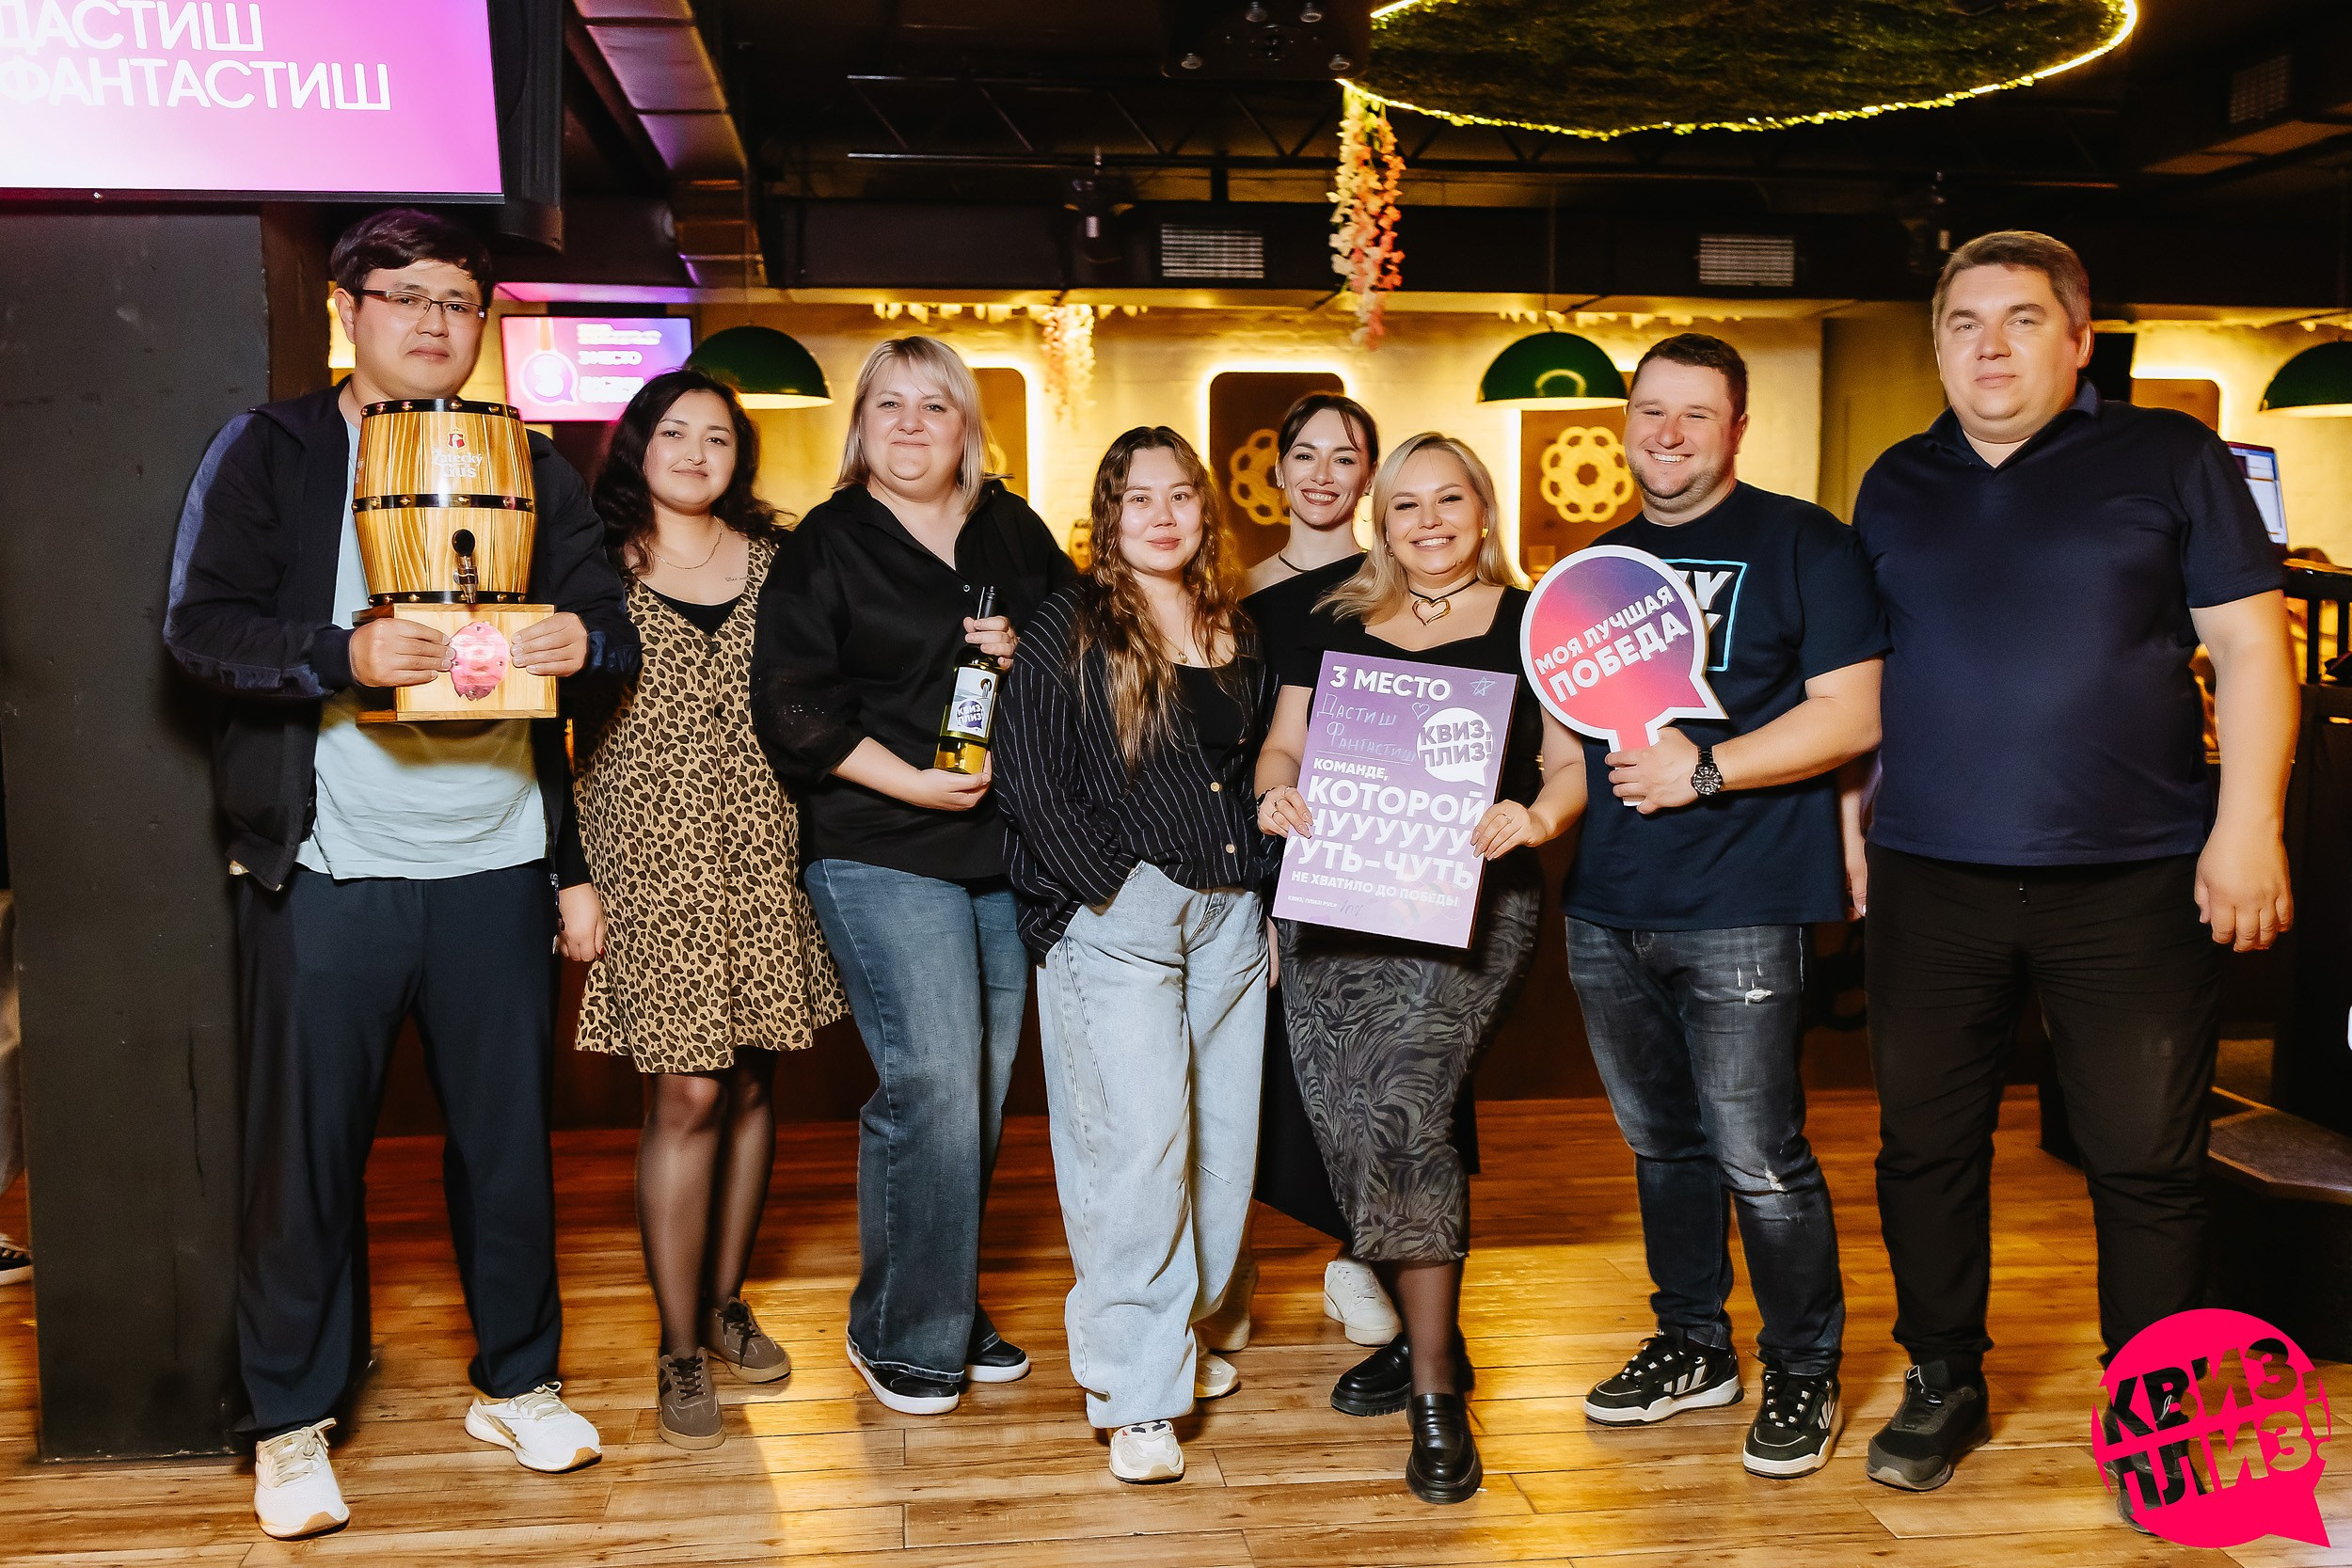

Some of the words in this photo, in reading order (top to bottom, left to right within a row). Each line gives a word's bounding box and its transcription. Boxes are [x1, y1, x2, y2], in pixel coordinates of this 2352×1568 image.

[0, 56, 391, 111] ФАНТАСТИШ
[1534, 637, 1583, 675] МОЯ
[1582, 585, 1675, 649] ЛУЧШАЯ
[1549, 610, 1689, 703] ПОБЕДА
[1329, 665, 1348, 688] 3
[1353, 668, 1451, 702] МЕСТО
[1313, 757, 1389, 782] КОМАНДЕ,
[1308, 776, 1486, 827] КОТОРОЙ
[1291, 870, 1309, 883] НЕ
[1311, 873, 1374, 894] ХВАТИЛО
[1375, 884, 1397, 897] ДО
